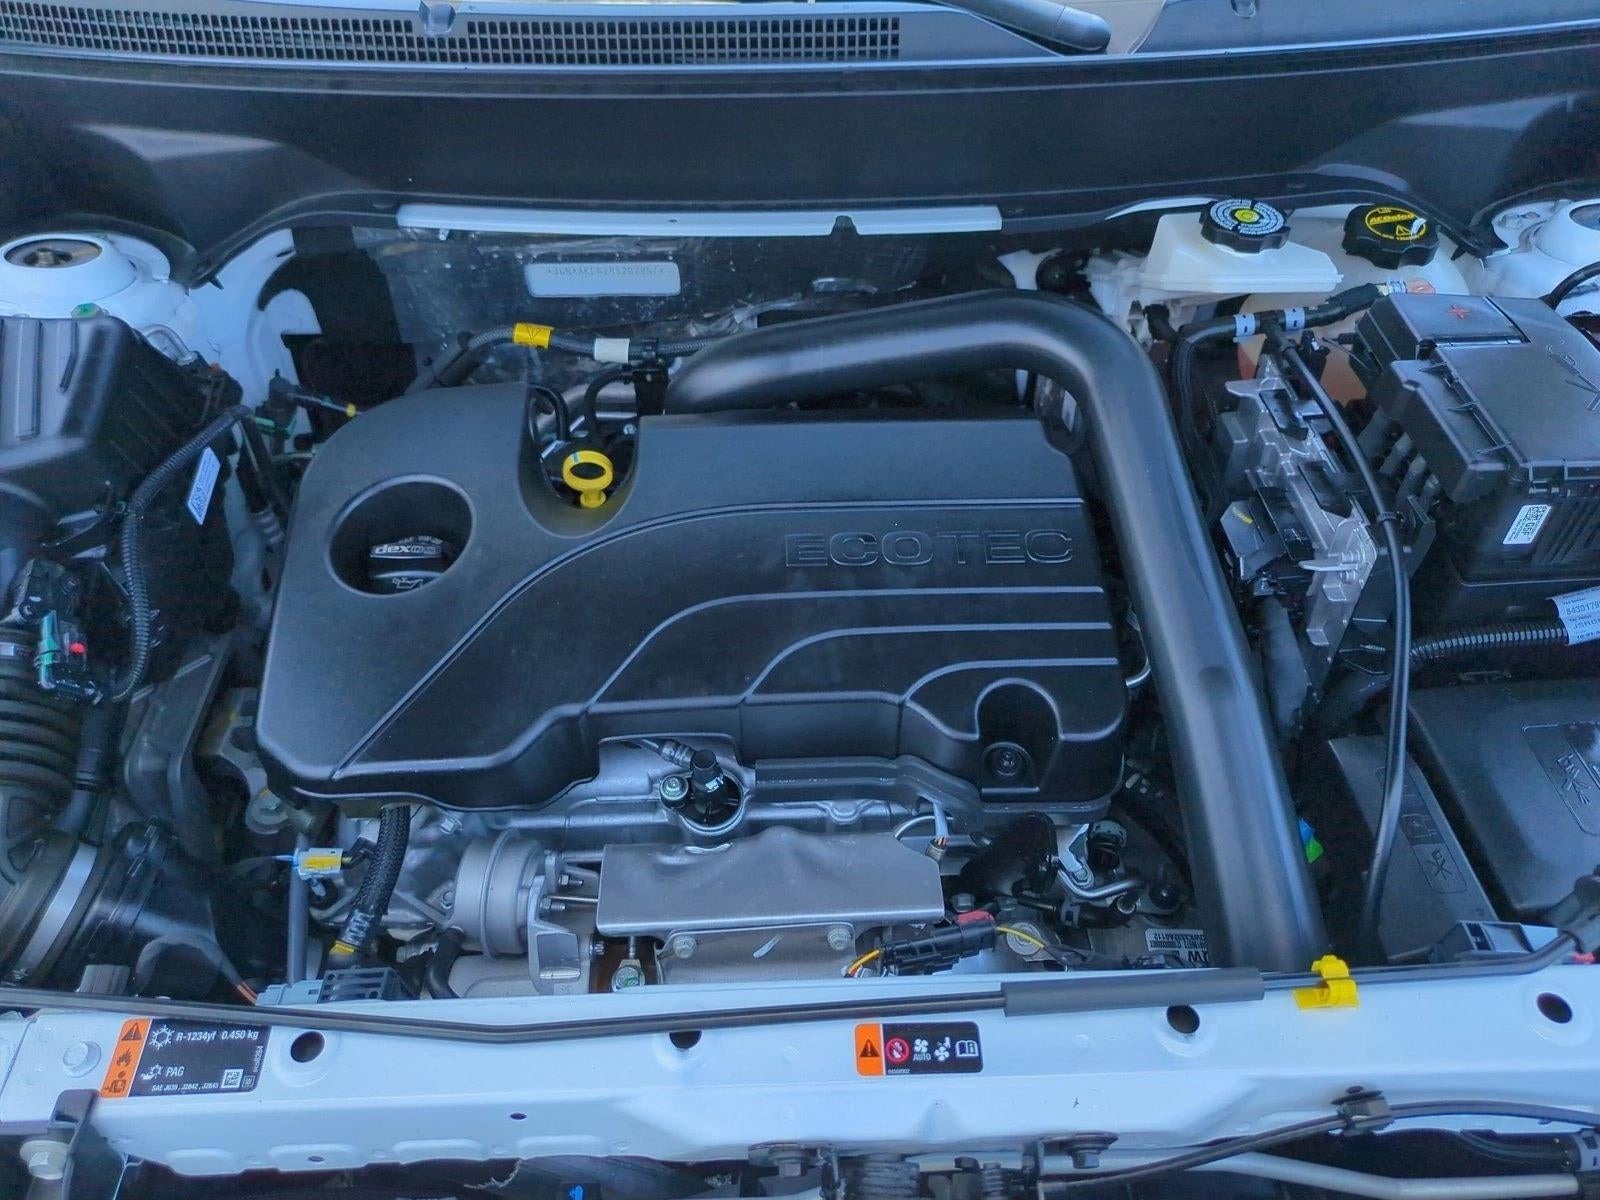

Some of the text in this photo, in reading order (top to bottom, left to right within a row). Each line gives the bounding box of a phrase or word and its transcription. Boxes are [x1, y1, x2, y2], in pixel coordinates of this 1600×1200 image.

[785, 529, 1073, 567] ECOTEC
[221, 1030, 246, 1040] 0.450
[247, 1030, 259, 1040] kg
[913, 1053, 931, 1061] AUTO
[166, 1066, 185, 1076] PAG
